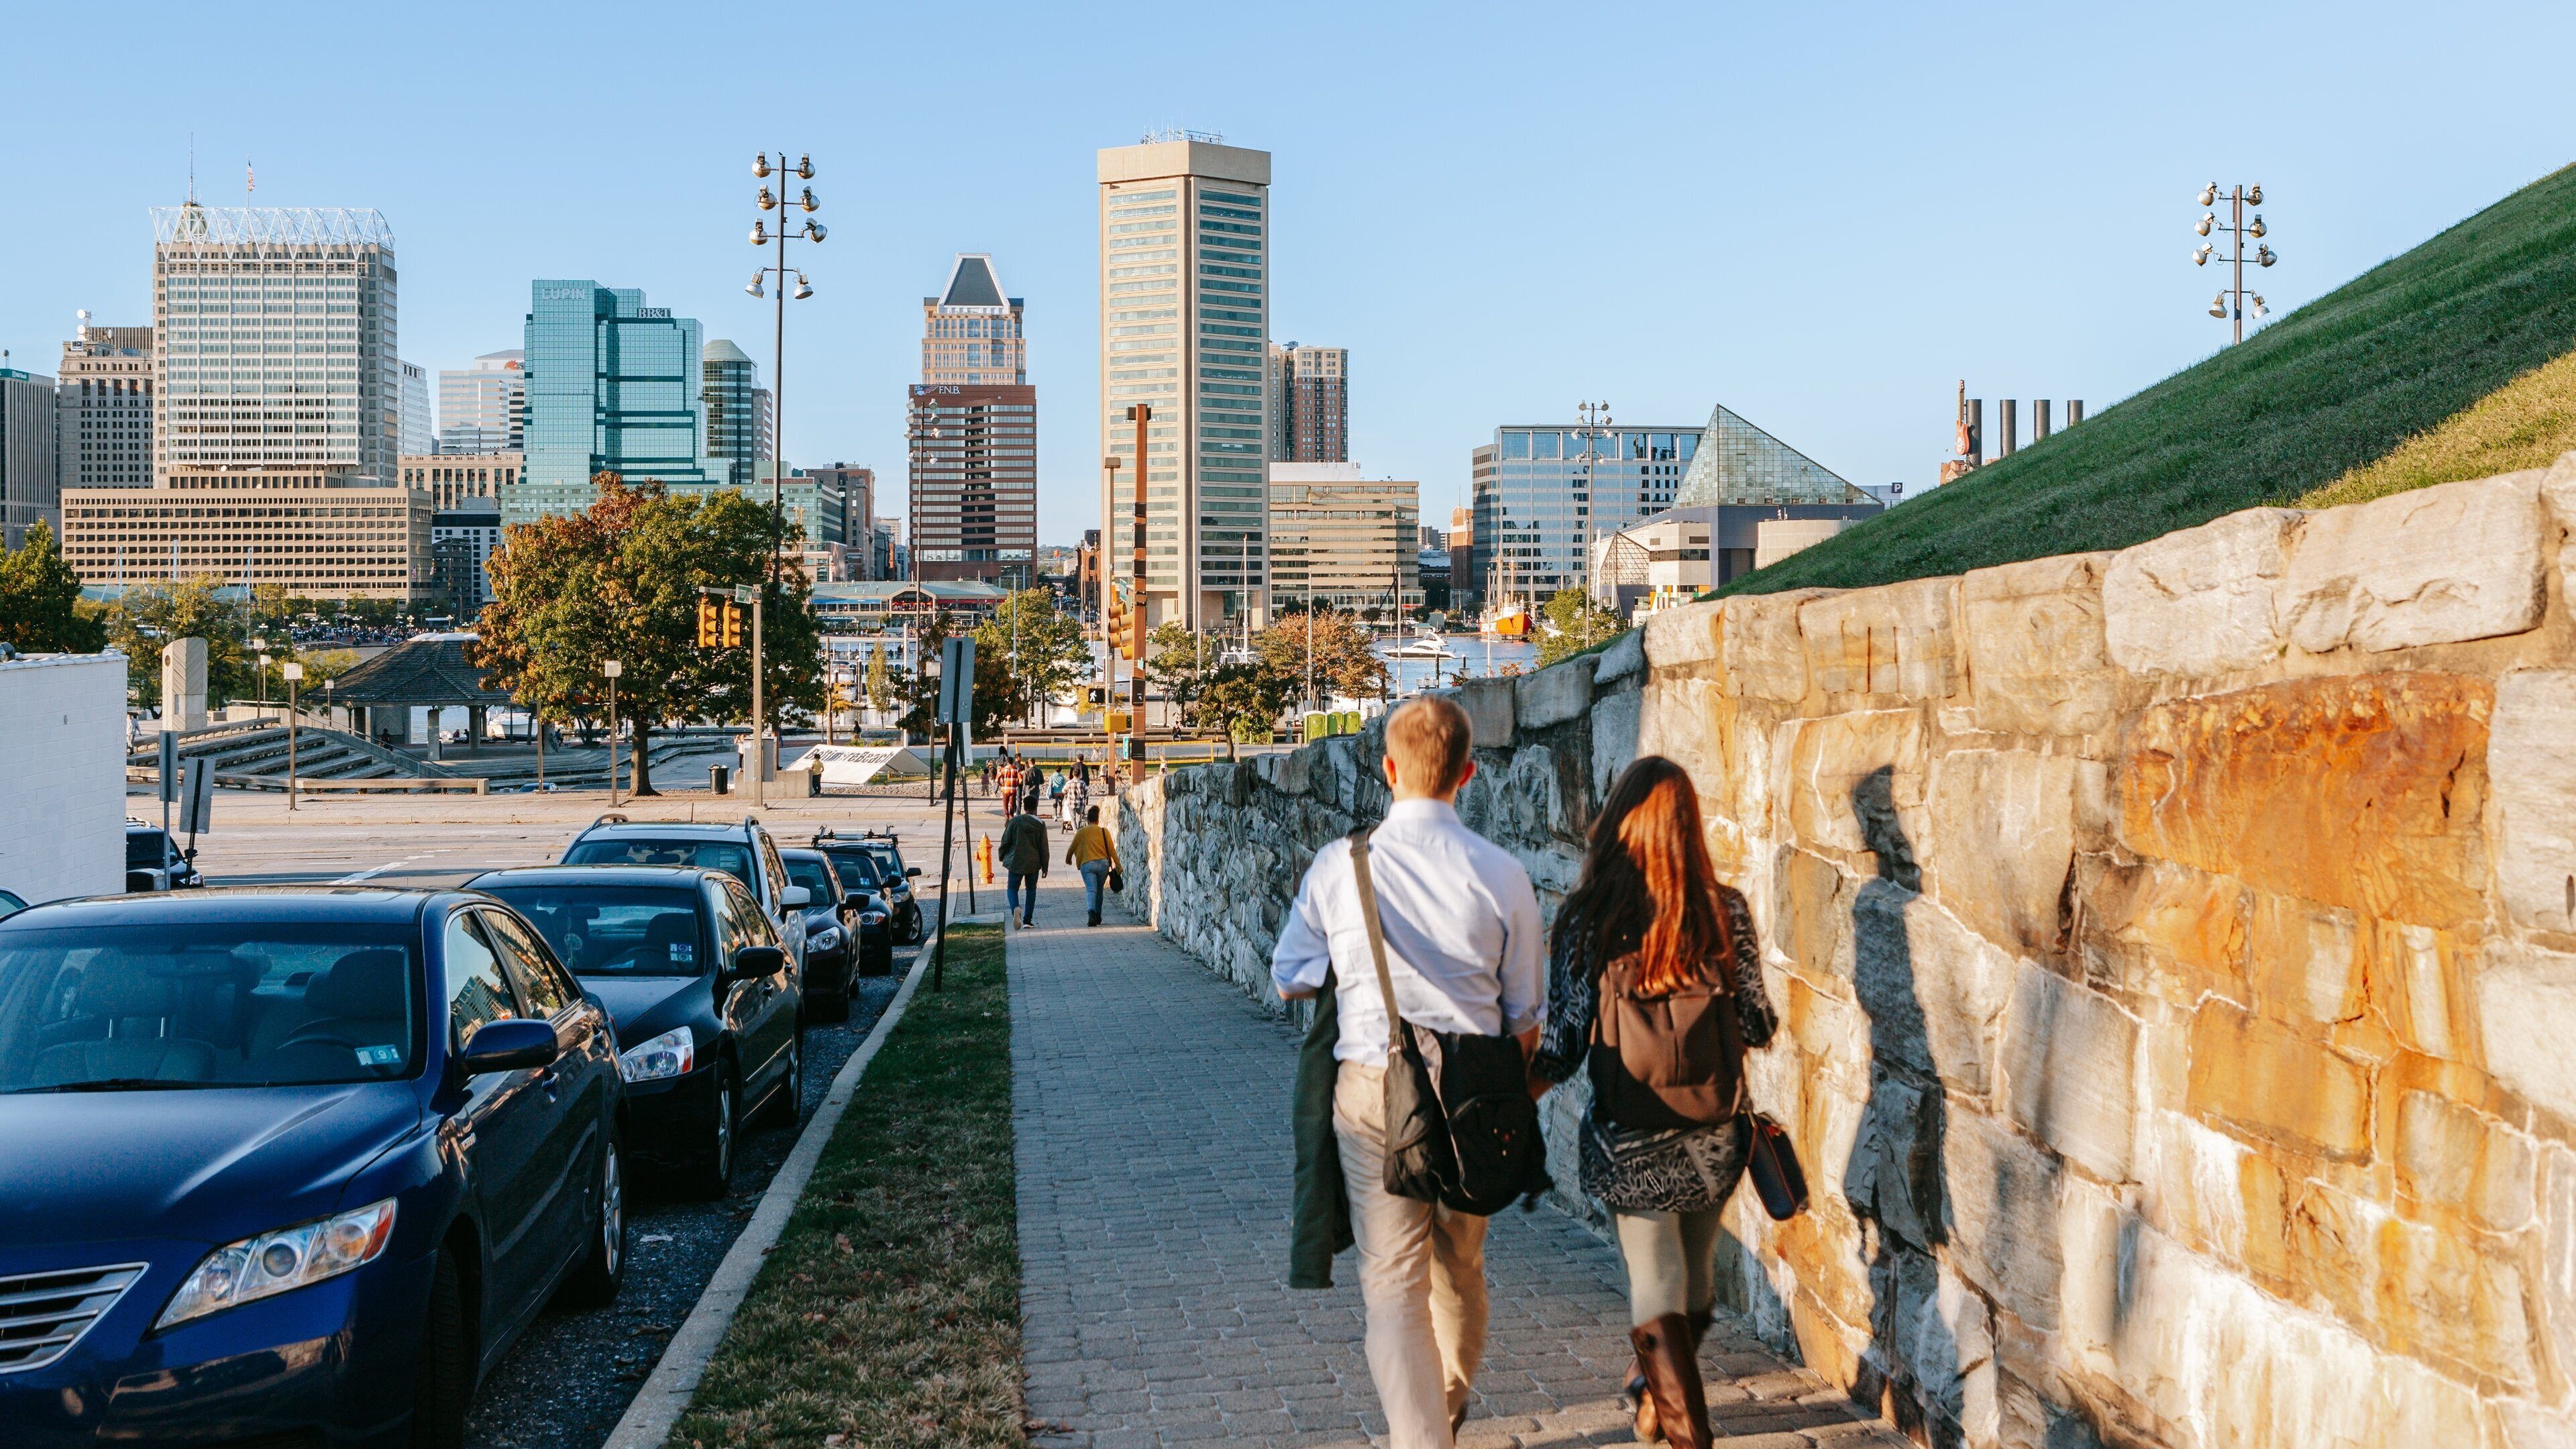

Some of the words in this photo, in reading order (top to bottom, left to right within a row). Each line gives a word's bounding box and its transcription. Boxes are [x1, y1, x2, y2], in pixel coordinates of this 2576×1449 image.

[542, 288, 584, 300] LUPIN
[638, 309, 671, 318] BB&T
[1894, 484, 1901, 492] P
[804, 748, 894, 763] BaltimreBeach
